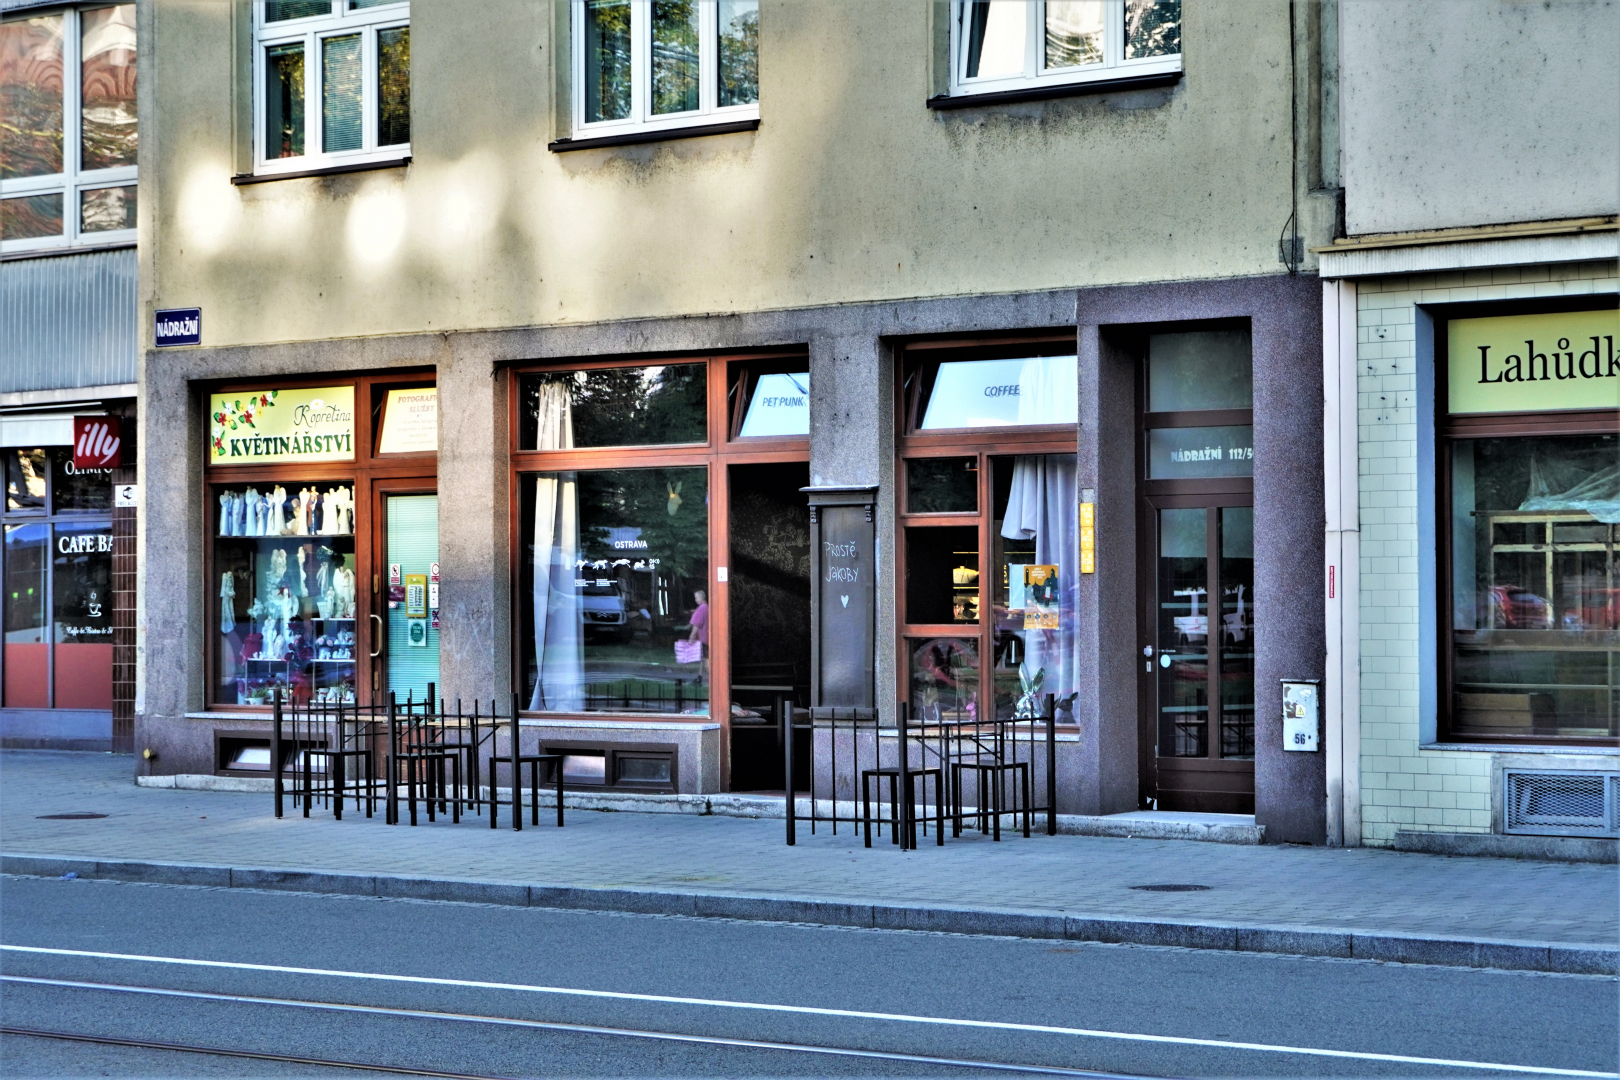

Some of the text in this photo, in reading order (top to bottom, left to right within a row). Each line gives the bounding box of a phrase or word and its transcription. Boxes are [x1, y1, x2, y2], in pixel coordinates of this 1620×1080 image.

[157, 316, 198, 337] NÁDRAŽNÍ
[1477, 335, 1620, 383] Lahůdk
[984, 385, 1020, 397] COFFEE
[763, 397, 804, 407] PET PUNK
[77, 422, 120, 464] illy
[230, 429, 351, 456] KVĚTINÁŘSTVÍ
[1171, 446, 1254, 462] NÁDRAŽNÍ 112/5
[58, 536, 95, 553] CAFE
[615, 541, 647, 549] OSTRAVA
[1295, 733, 1305, 744] 56
